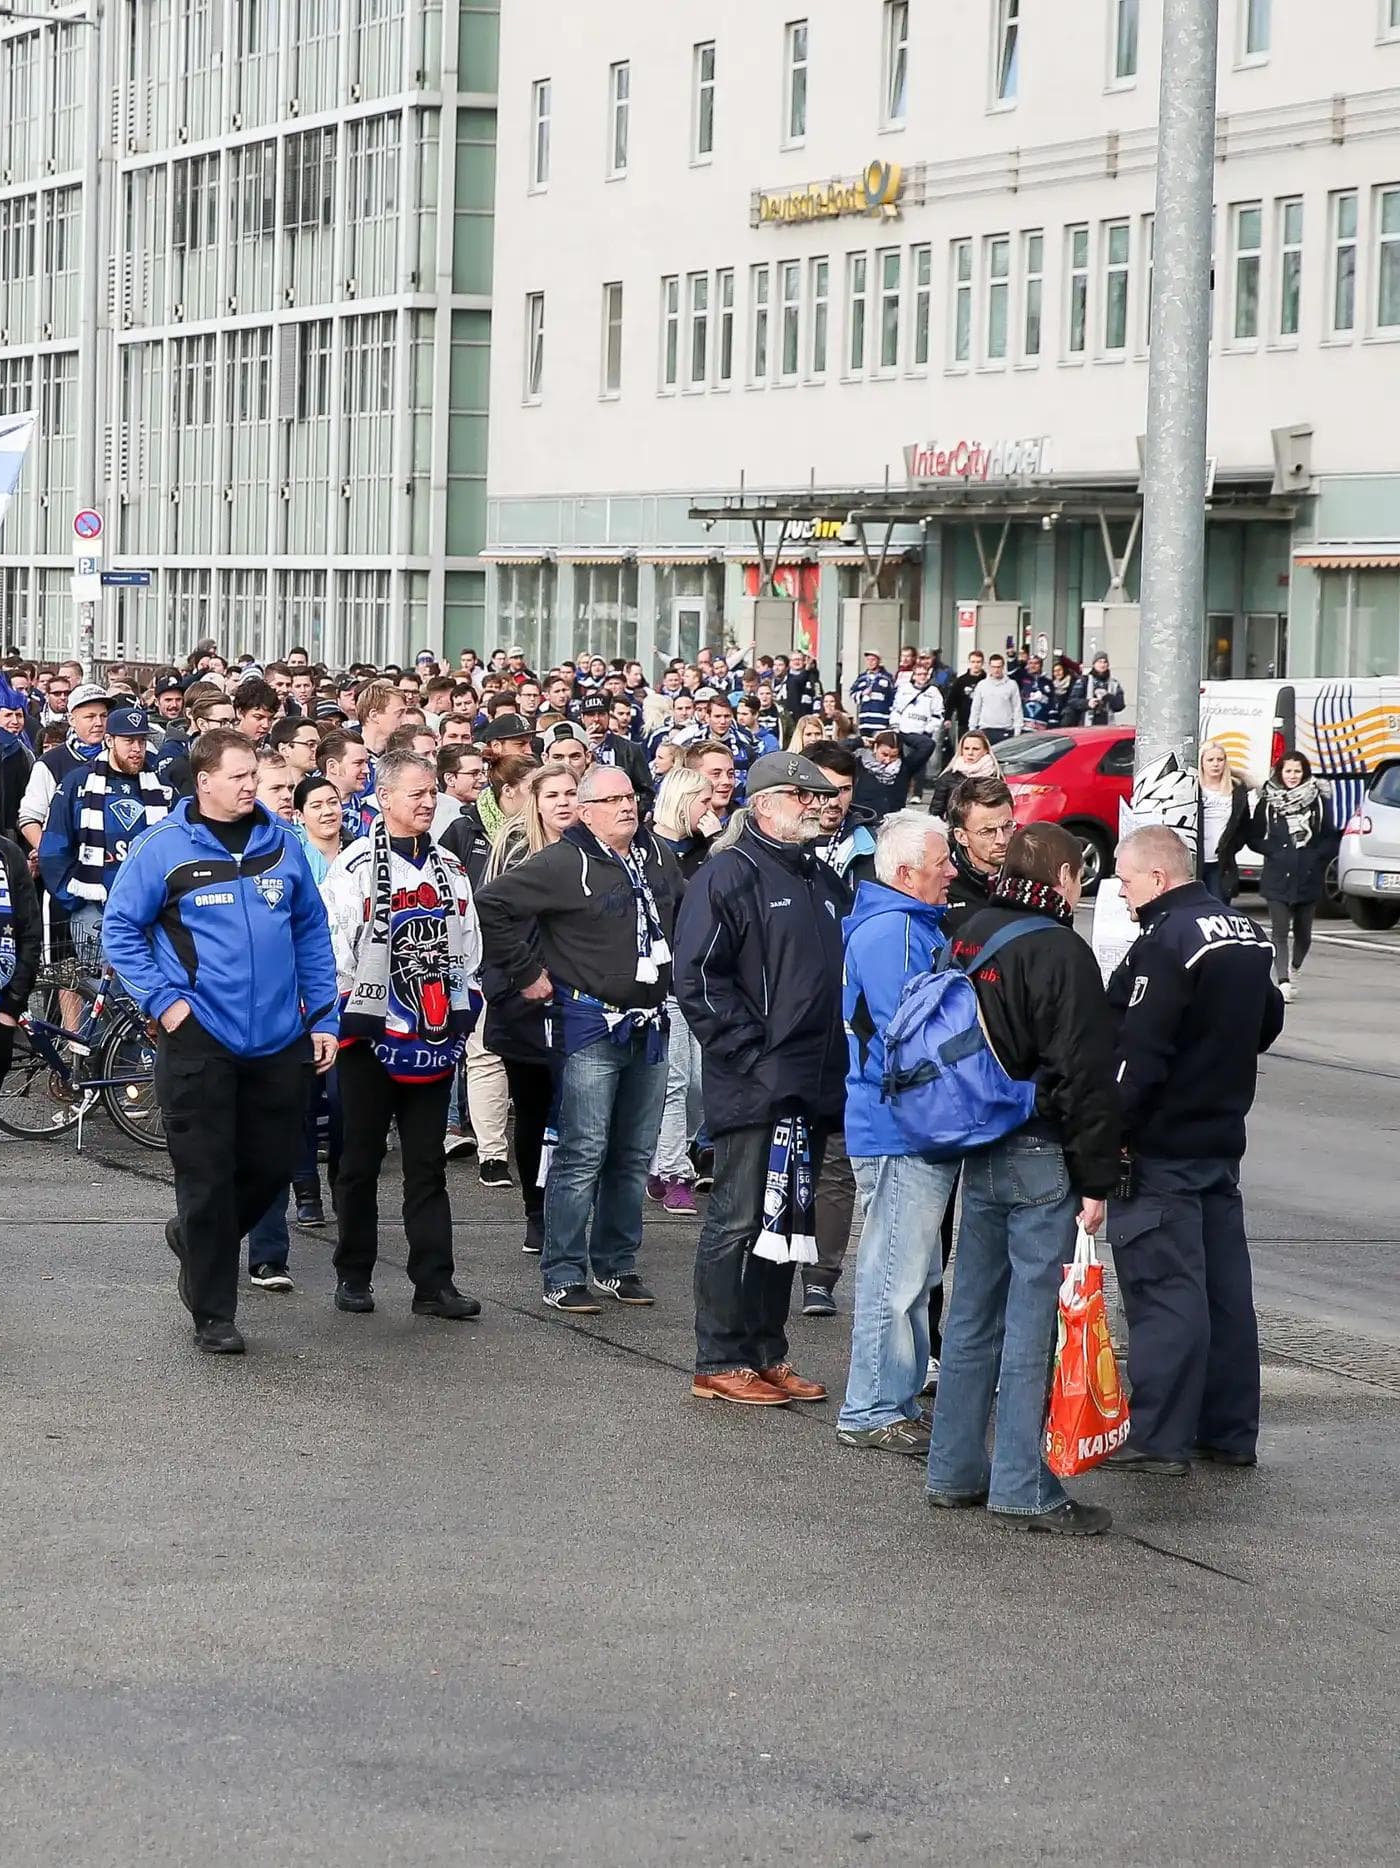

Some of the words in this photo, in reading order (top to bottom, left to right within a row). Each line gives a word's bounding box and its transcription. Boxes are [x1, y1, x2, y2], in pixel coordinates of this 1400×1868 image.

[759, 184, 824, 222] Deutsche
[827, 181, 860, 215] Post
[194, 893, 235, 908] ORDNER
[414, 1049, 448, 1069] Die
